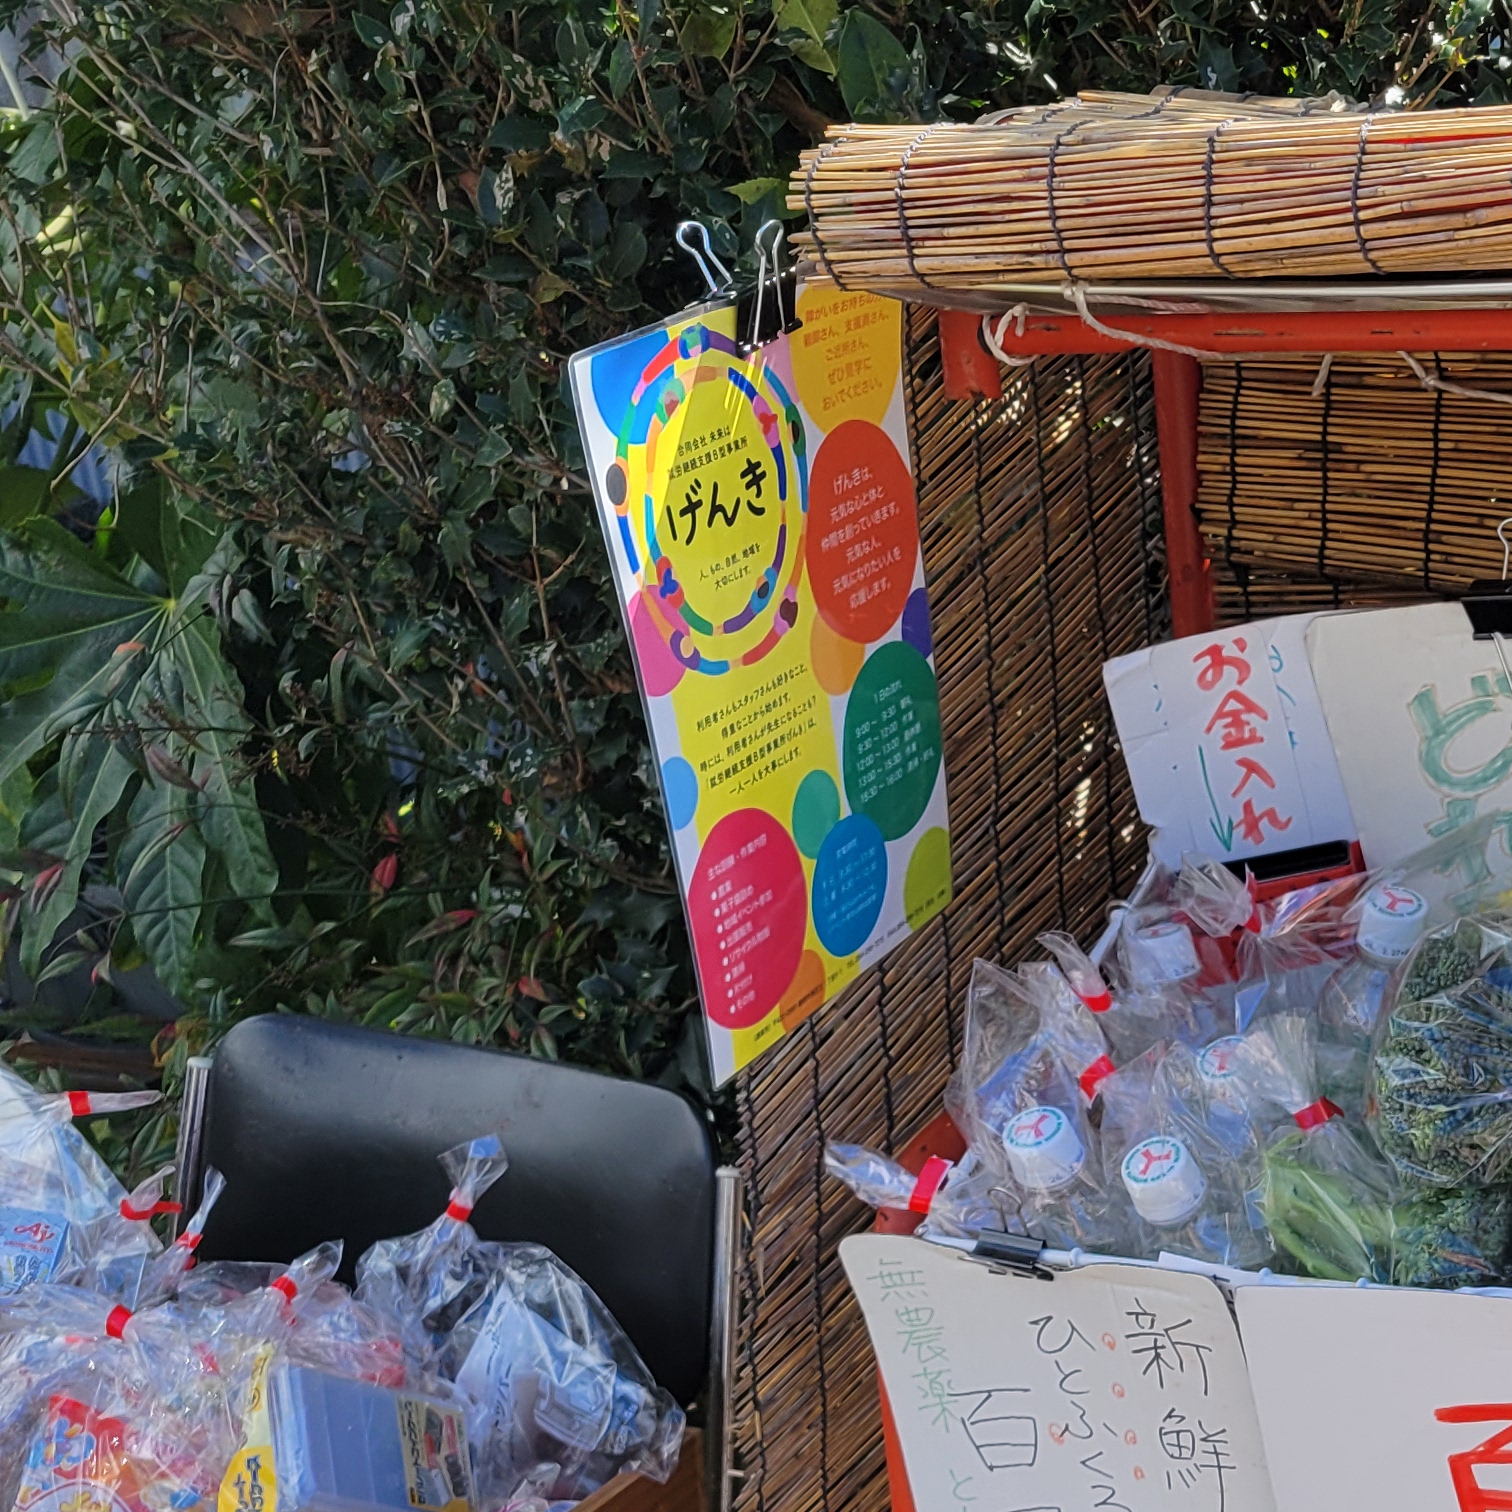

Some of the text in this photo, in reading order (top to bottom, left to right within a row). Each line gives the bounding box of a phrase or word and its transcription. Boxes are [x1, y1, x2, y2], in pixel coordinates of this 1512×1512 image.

[665, 456, 768, 547] げんき
[1193, 637, 1292, 846] お金入れ
[867, 1258, 960, 1434] 無農薬
